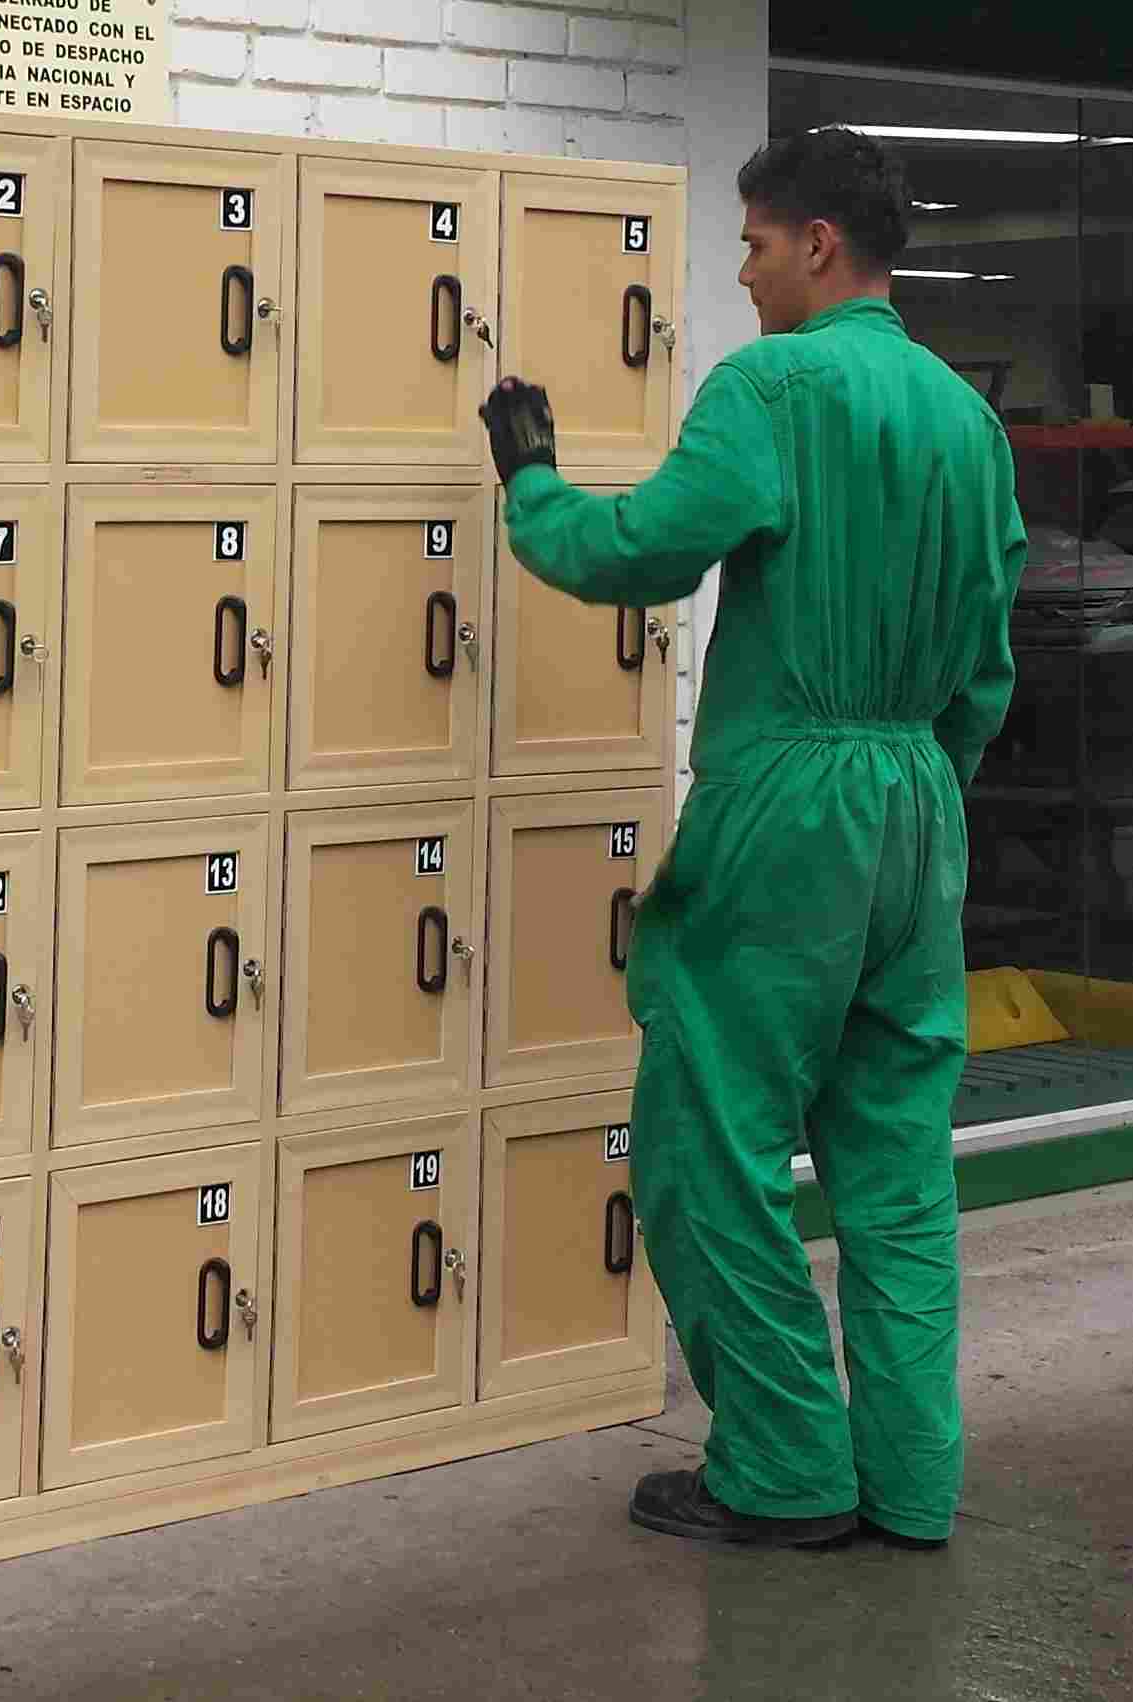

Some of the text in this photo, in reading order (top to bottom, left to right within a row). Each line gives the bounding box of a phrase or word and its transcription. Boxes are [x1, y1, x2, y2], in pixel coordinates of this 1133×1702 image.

[90, 0, 111, 13] DE
[89, 21, 124, 39] CON
[134, 25, 155, 41] EL
[22, 41, 45, 57] DE
[55, 43, 145, 65] DESPACHO
[27, 66, 115, 88] NACIONAL
[124, 73, 135, 89] Y
[27, 91, 49, 108] EN
[60, 93, 132, 113] ESPACIO
[229, 195, 245, 223] 3
[436, 208, 452, 236] 4
[630, 222, 643, 248] 5
[222, 527, 237, 555] 8
[433, 526, 447, 552] 9
[615, 828, 633, 853] 15
[421, 841, 441, 869] 14
[211, 858, 233, 887] 13
[609, 1128, 628, 1155] 20
[416, 1155, 437, 1183] 19
[203, 1189, 226, 1218] 18
